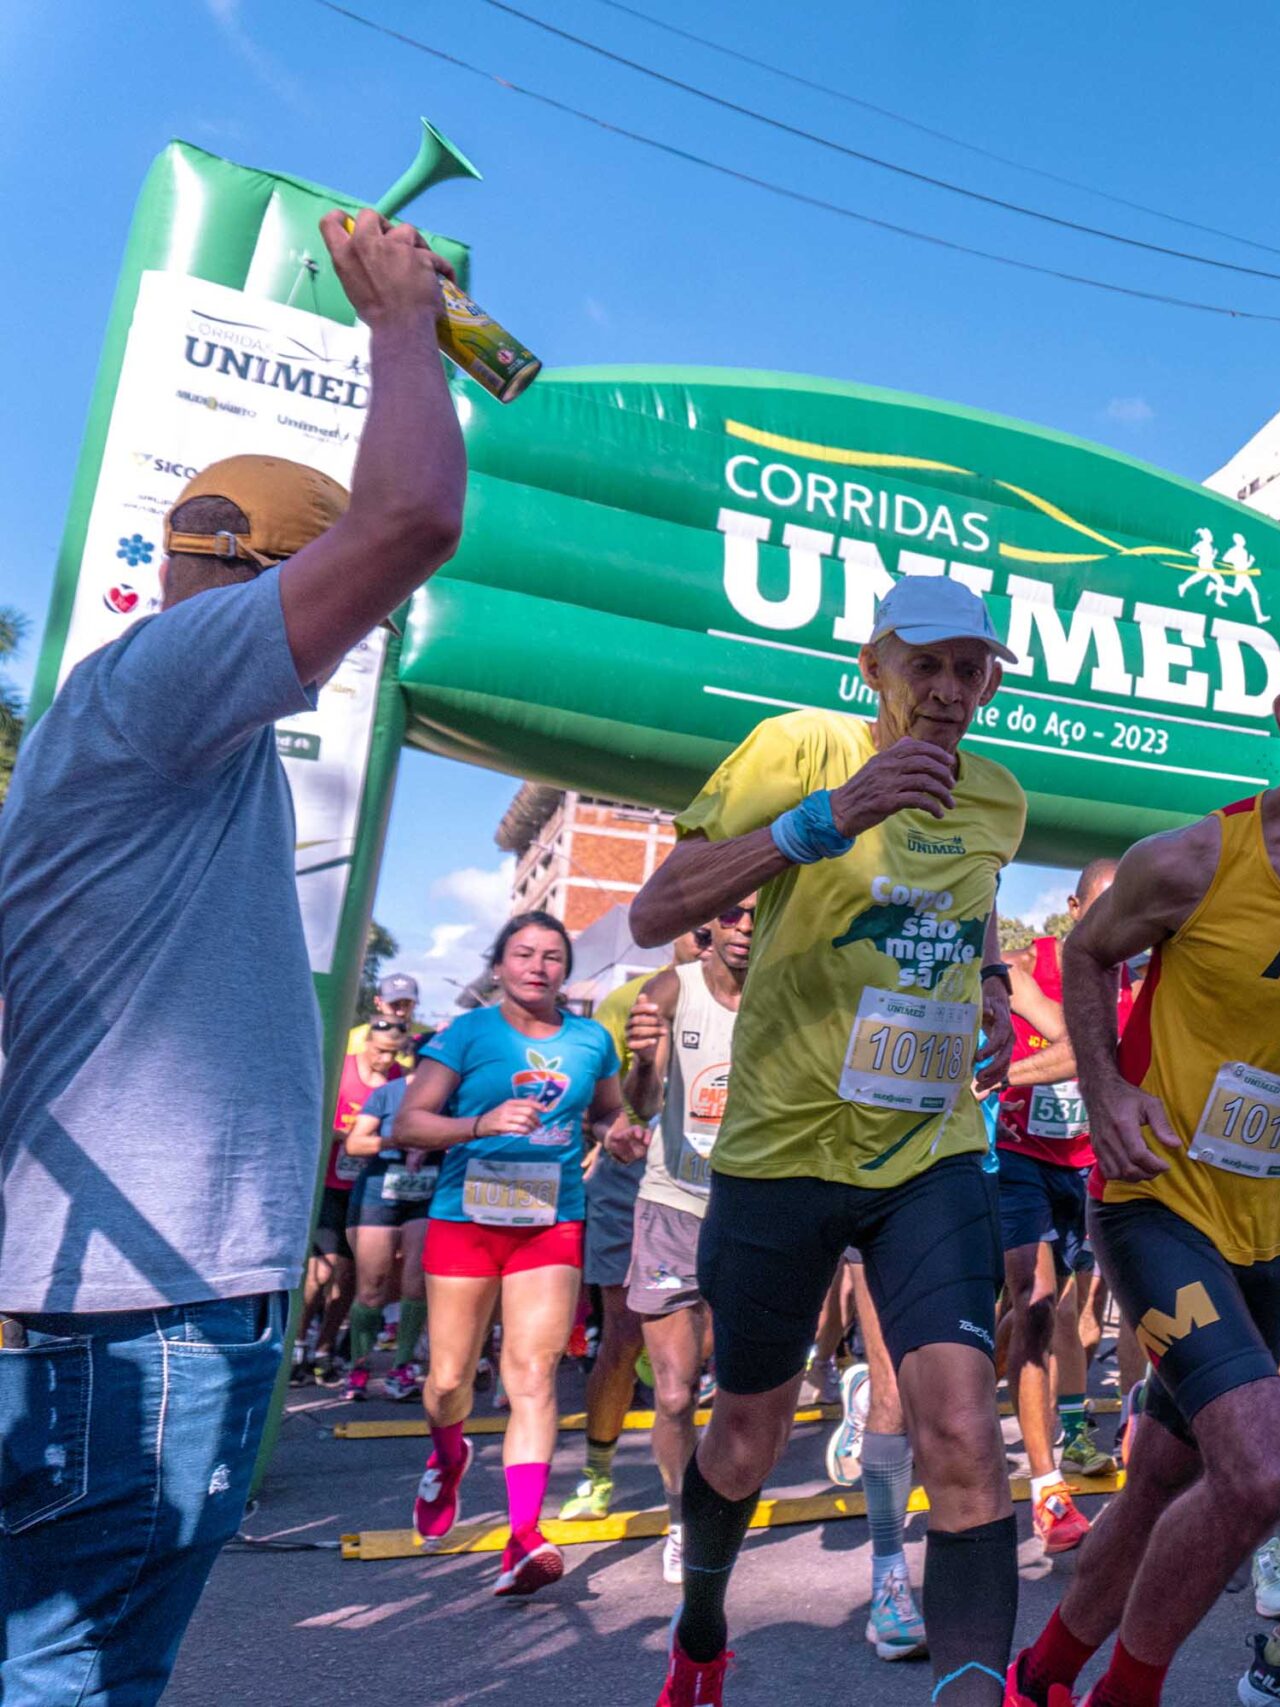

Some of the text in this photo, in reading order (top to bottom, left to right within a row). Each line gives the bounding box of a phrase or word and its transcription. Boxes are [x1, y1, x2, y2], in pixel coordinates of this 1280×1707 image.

[185, 335, 369, 409] UNIMED
[154, 459, 198, 480] SICO
[725, 455, 991, 553] CORRIDAS
[1007, 704, 1037, 734] do
[1043, 711, 1087, 748] Aço
[1110, 720, 1169, 756] 2023
[907, 839, 967, 855] UNIMED
[871, 875, 954, 916] Corpo
[902, 911, 958, 939] são
[886, 937, 976, 965] mente
[898, 961, 933, 989] sã
[869, 1025, 965, 1080] 10118
[1038, 1097, 1088, 1122] 531
